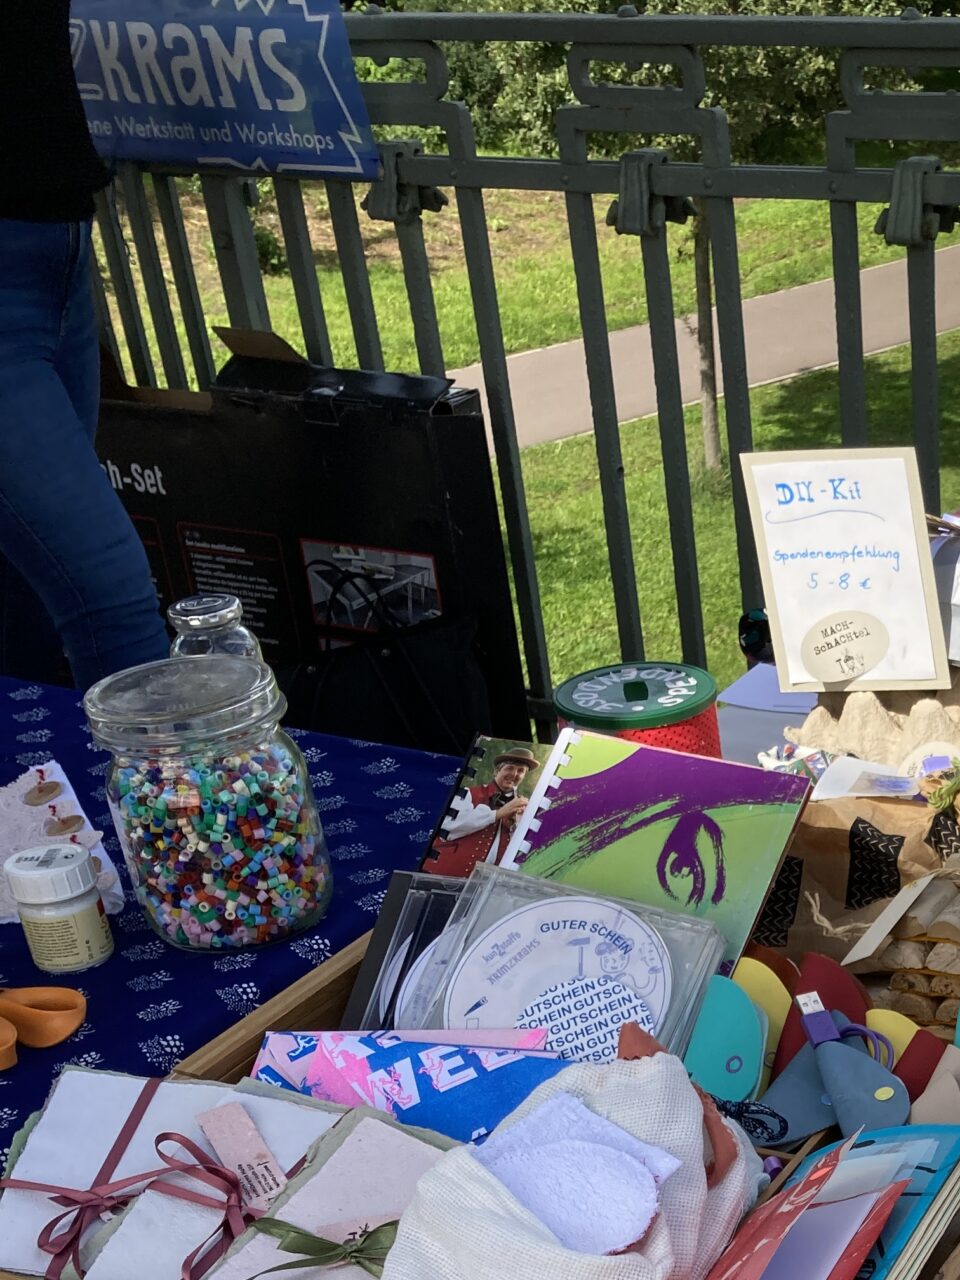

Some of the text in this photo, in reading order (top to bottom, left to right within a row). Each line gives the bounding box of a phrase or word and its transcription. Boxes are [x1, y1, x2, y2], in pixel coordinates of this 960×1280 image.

[114, 115, 195, 141] Werkstatt
[200, 121, 233, 143] und
[234, 122, 334, 155] Workshops
[540, 919, 633, 956] GUTER SCHEIN
[551, 994, 632, 1035] GUTSCHEIN
